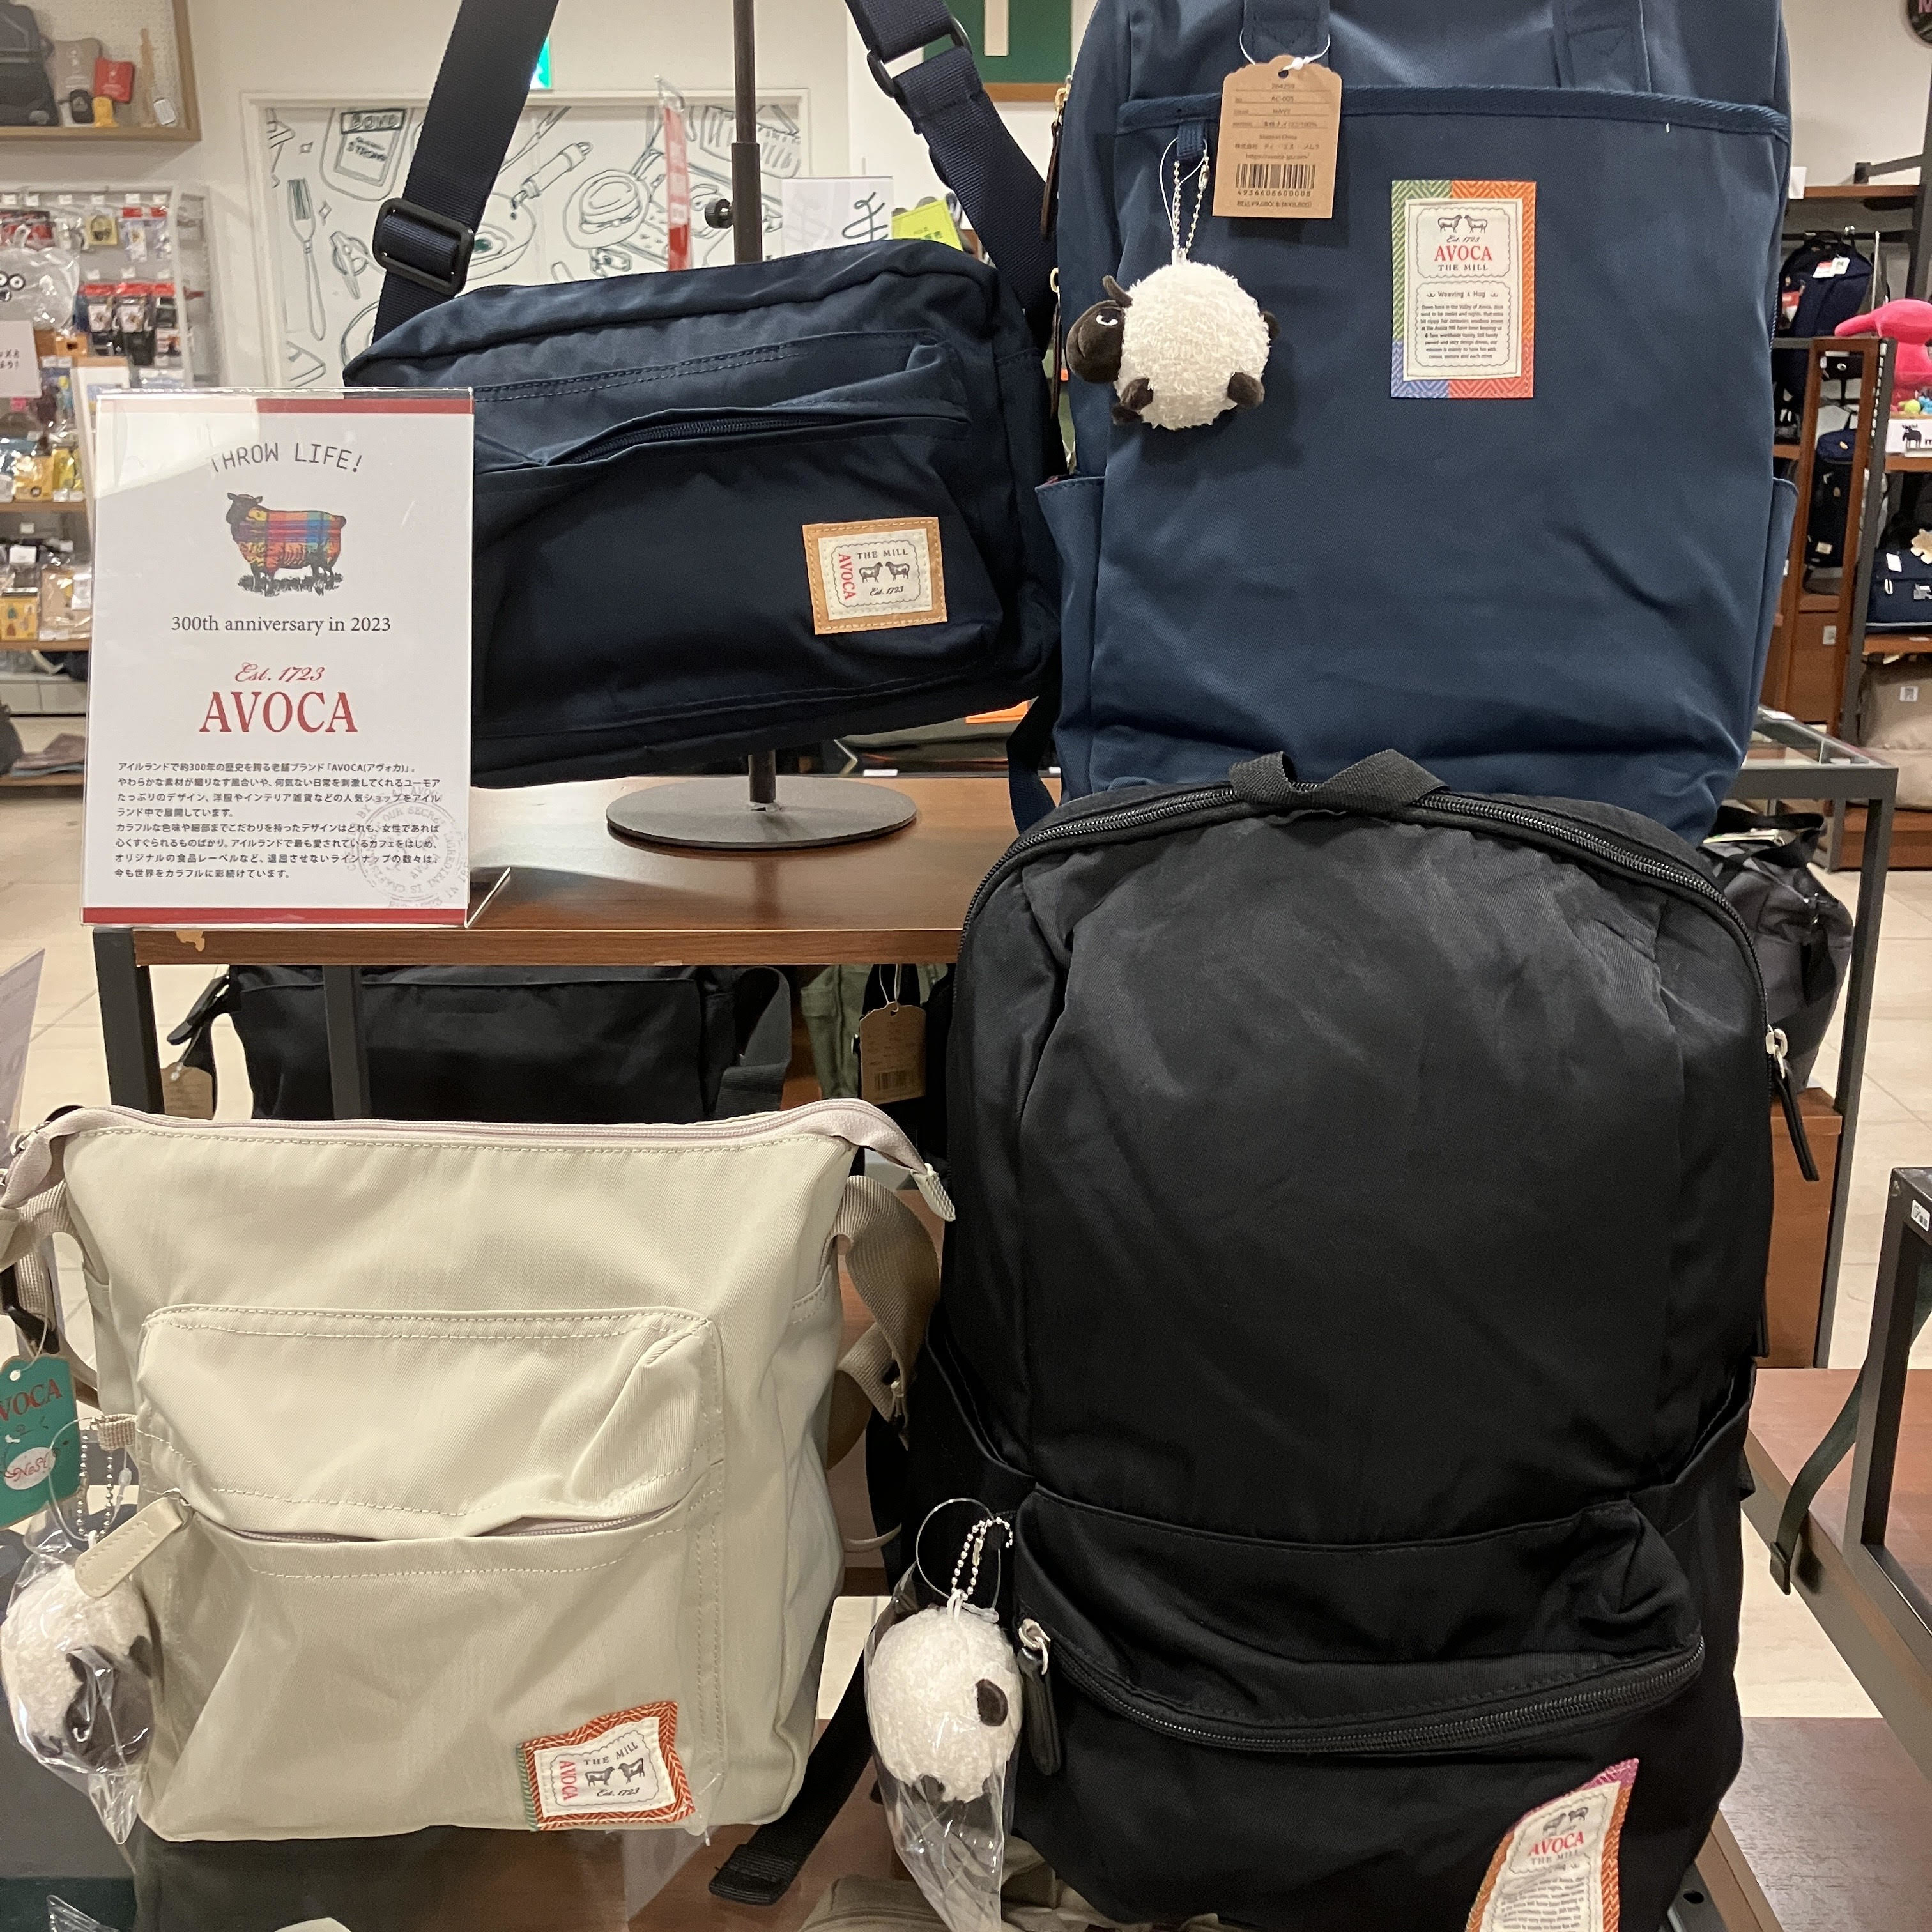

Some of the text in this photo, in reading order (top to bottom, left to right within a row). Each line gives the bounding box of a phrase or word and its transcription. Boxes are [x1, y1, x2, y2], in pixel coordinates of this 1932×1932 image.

[1238, 189, 1311, 197] 4936606600008
[1434, 245, 1493, 261] AVOCA
[294, 442, 364, 473] LIFE!
[856, 548, 908, 560] THE MILL
[838, 553, 857, 601] AVOCA
[886, 586, 904, 595] 1723
[171, 615, 392, 636] 300th anniversary in 2023
[234, 662, 326, 683] Est. 1723
[199, 691, 358, 733] AVOCA
[0, 1379, 63, 1422] VOCA
[582, 1741, 638, 1766] THE MILL
[559, 1760, 579, 1802] AVOCA
[1528, 1830, 1585, 1857] AVOCA
[1530, 1856, 1552, 1864] THE
